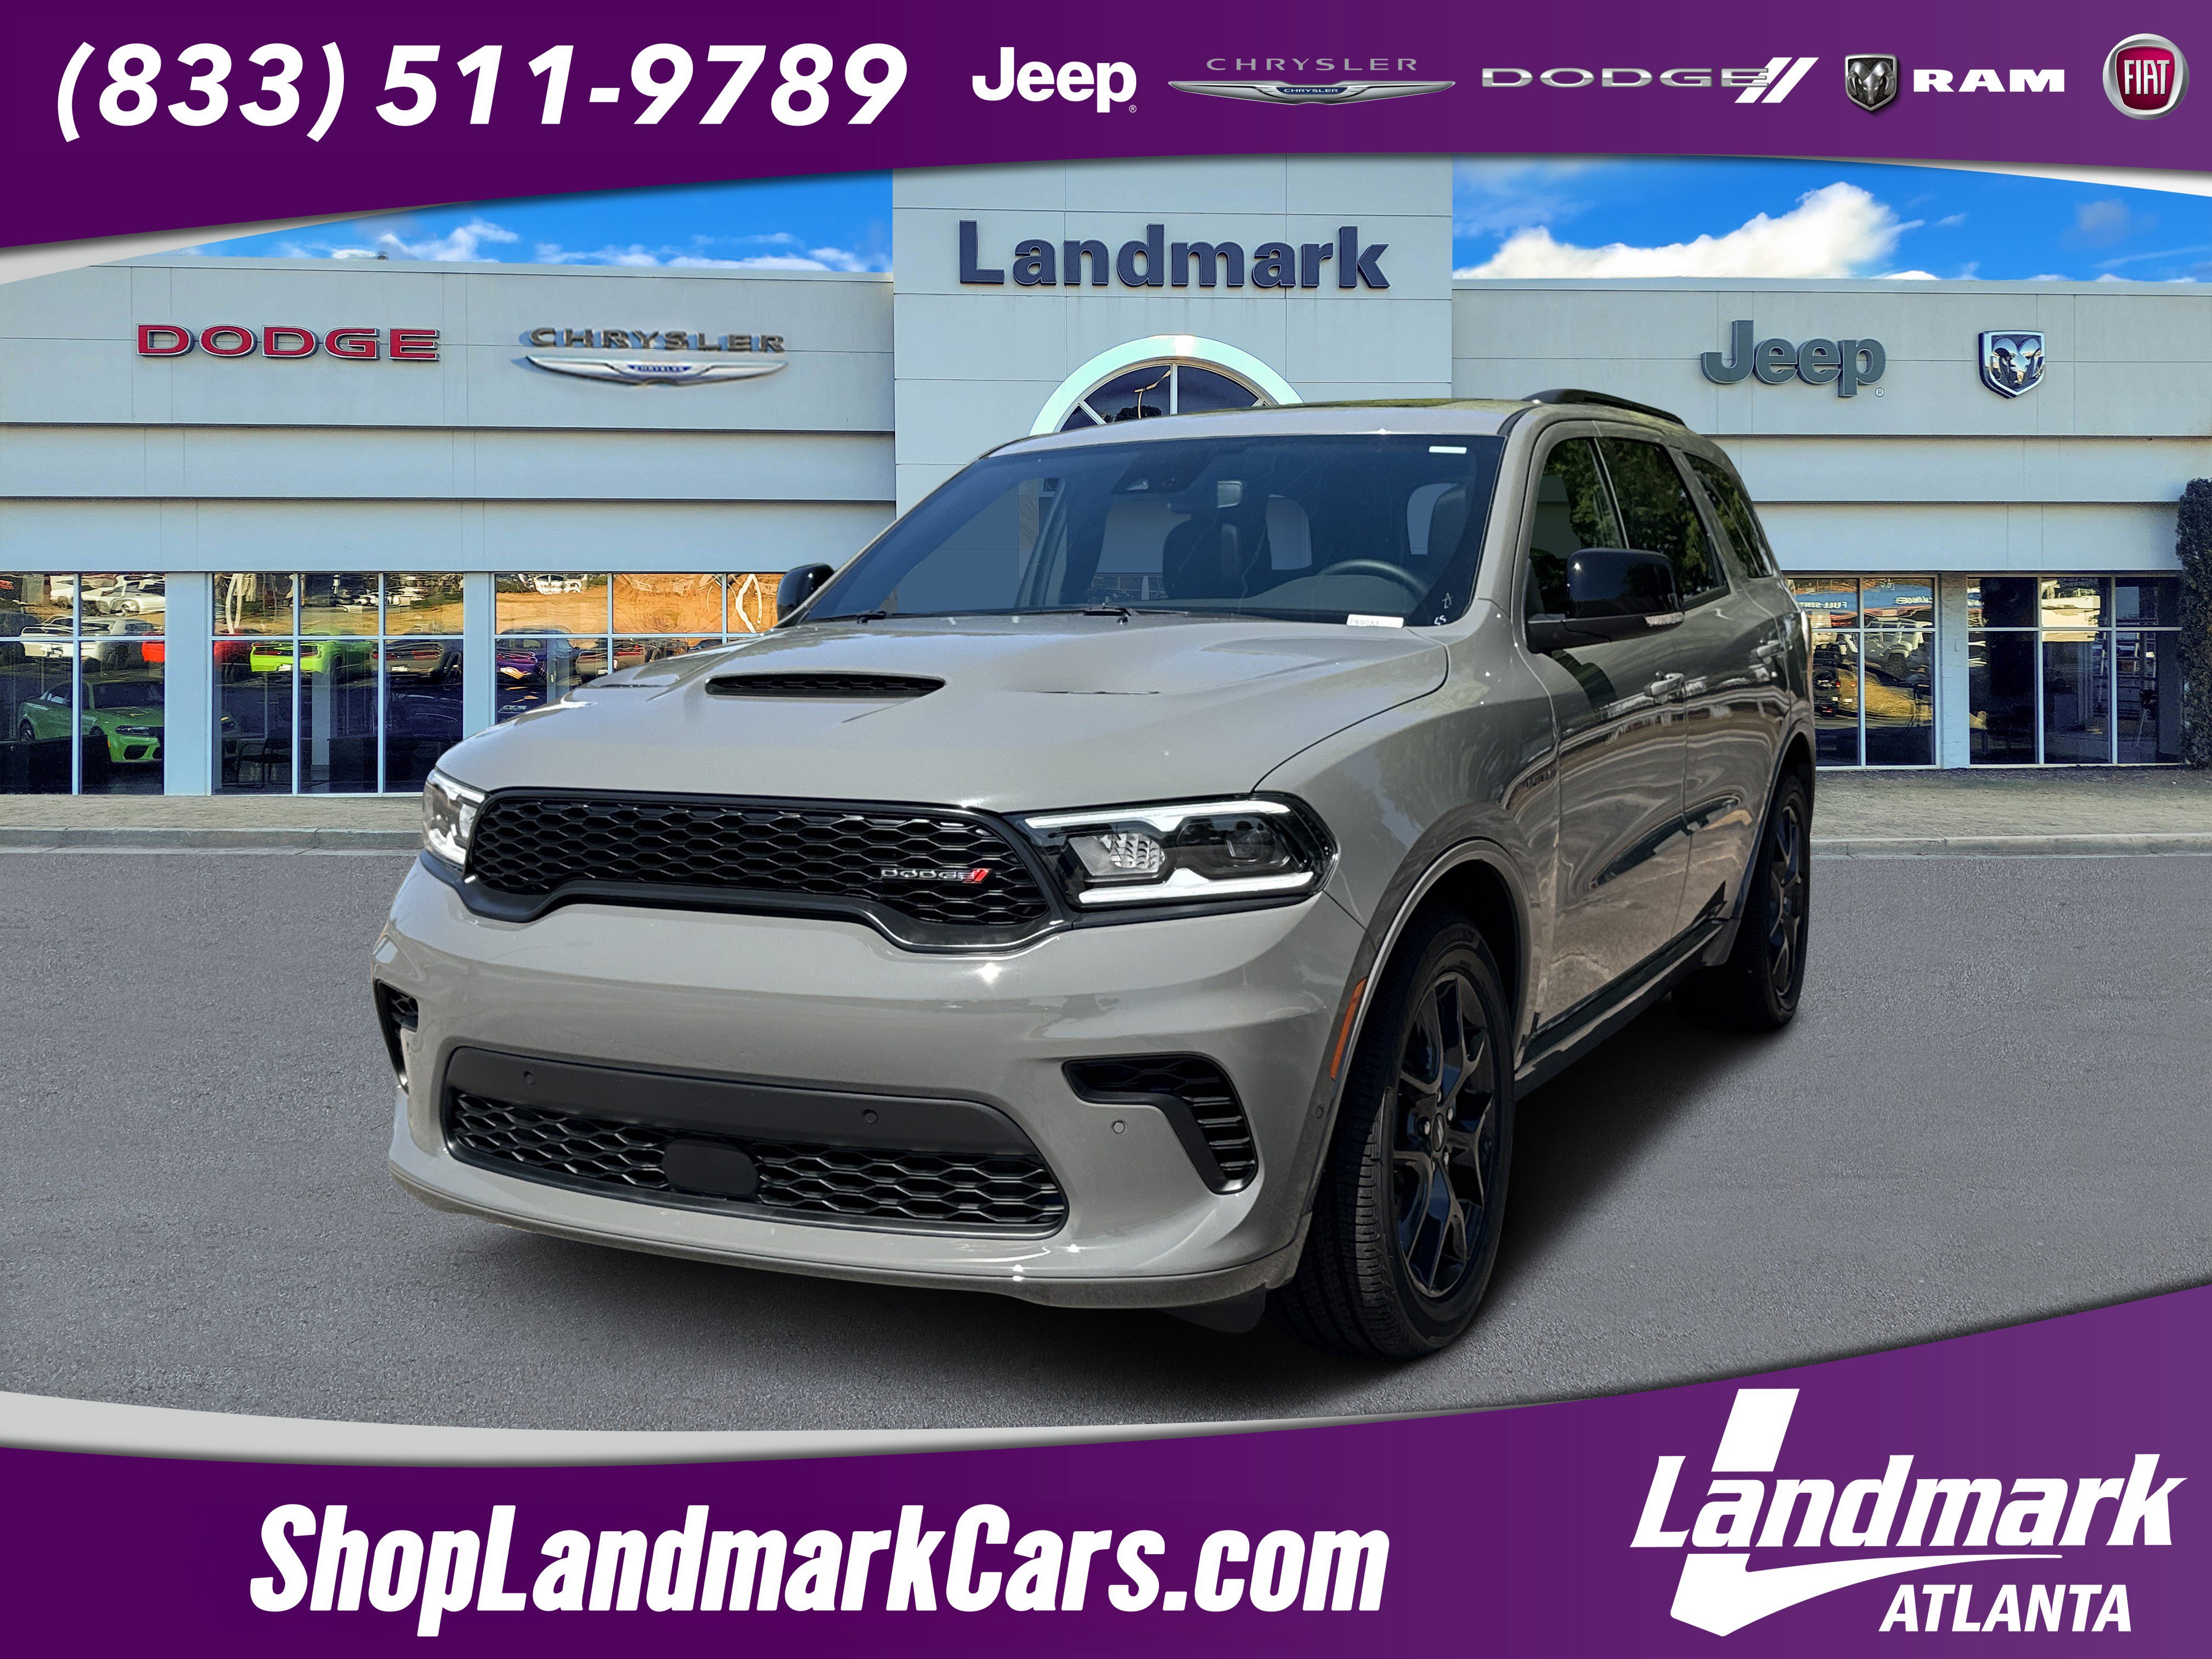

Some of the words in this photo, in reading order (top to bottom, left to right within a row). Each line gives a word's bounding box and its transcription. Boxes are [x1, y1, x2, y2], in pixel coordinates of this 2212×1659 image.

[958, 219, 1390, 289] Landmark
[137, 324, 439, 362] DODGE
[528, 327, 786, 353] CHRYSLER
[1701, 319, 1886, 398] Jeep
[881, 869, 975, 880] DODGE
